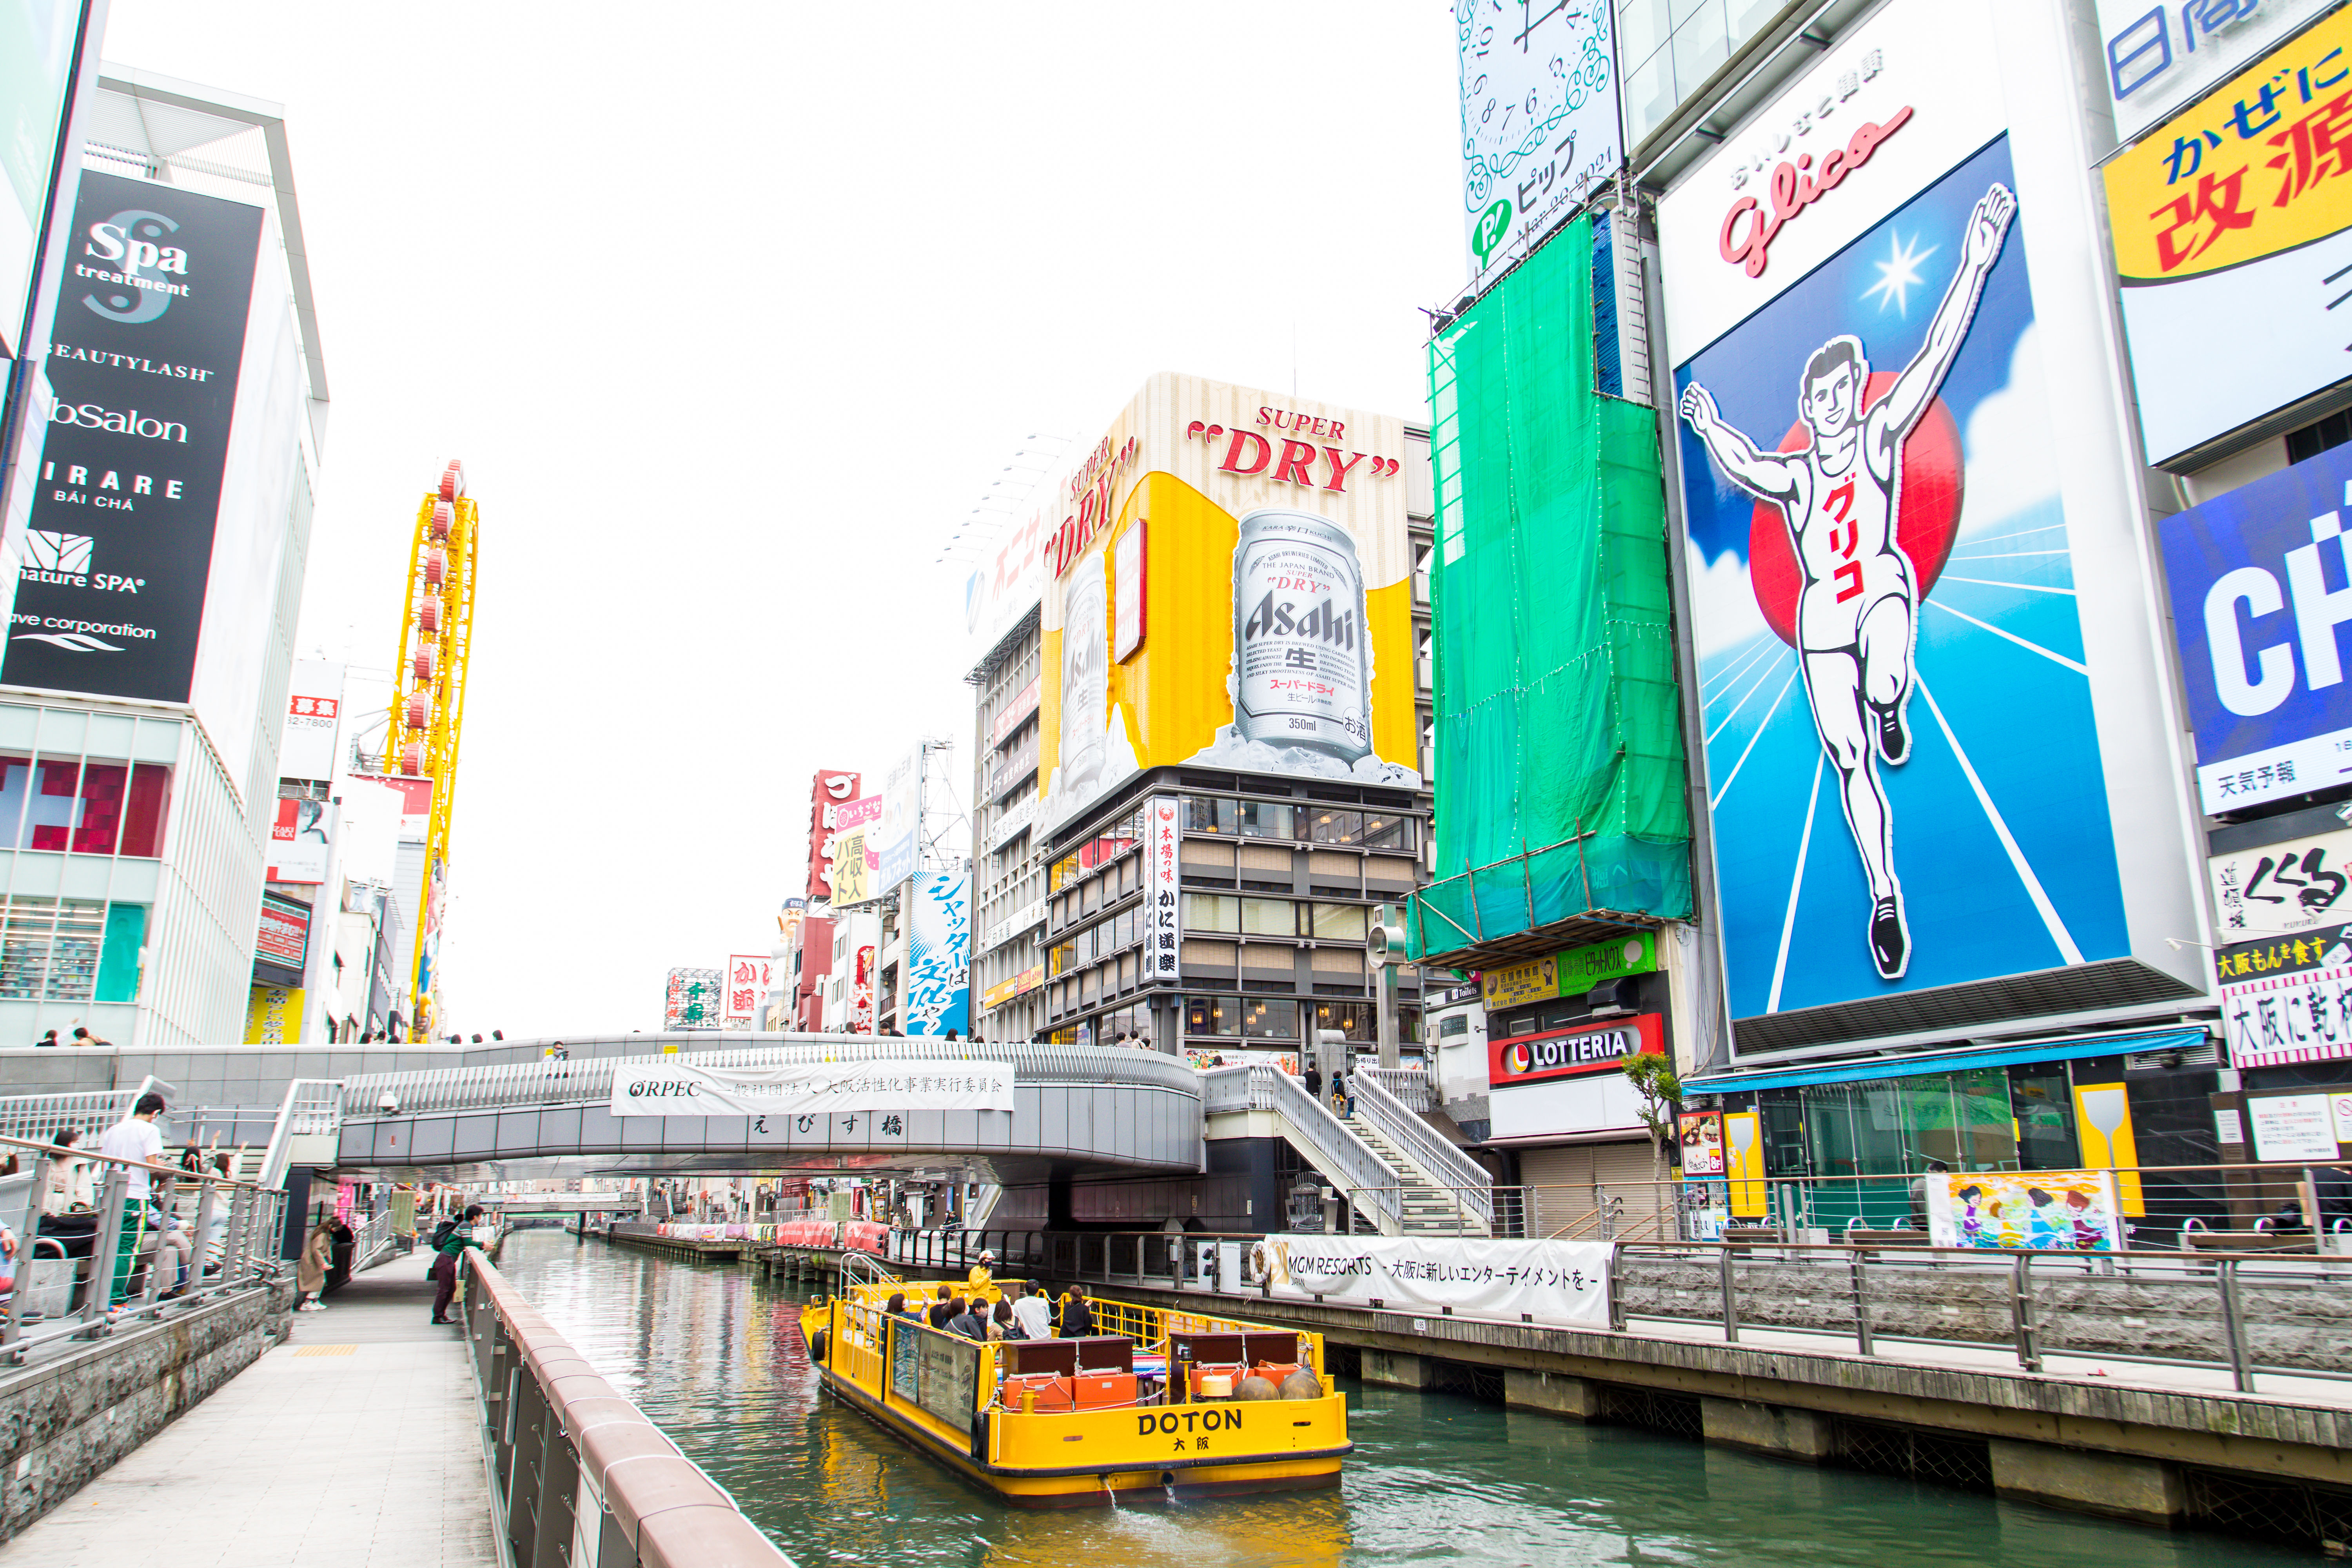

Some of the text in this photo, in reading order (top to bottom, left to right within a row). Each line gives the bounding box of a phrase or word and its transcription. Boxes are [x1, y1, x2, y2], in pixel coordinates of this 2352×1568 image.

[1566, 7, 1582, 30] 4
[1476, 26, 1493, 61] 10
[1549, 53, 1563, 78] 5
[1474, 74, 1488, 95] 9
[1482, 98, 1495, 123] 8
[1526, 87, 1537, 114] 6
[1502, 104, 1516, 131] 7
[2161, 46, 2350, 186] かぜに
[1517, 129, 1577, 214] ピップ
[1575, 146, 1612, 192] 2021
[2149, 89, 2352, 272] 改源
[85, 222, 189, 276] Spa
[75, 263, 191, 297] treatment
[1256, 406, 1345, 440] SUPER
[1070, 435, 1111, 503] SUPER
[1284, 525, 1309, 534] 辛口
[1309, 530, 1333, 541] KUCHI
[1822, 471, 1865, 604] グリコ
[1115, 526, 1140, 575] ASAHI
[1268, 550, 1328, 570] ASAHI BREWERIES LIMITED
[20, 568, 87, 587] nature
[1286, 570, 1313, 579] SUPER
[1308, 566, 1334, 579] BRAND
[1116, 572, 1140, 619] 1889
[44, 617, 157, 639] corporation
[1115, 608, 1140, 657] OSAKA
[1245, 589, 1354, 652] Asahi
[1285, 648, 1317, 671] 生
[1319, 660, 1343, 671] BREWING
[1330, 655, 1355, 671] INGREDIENTS
[1332, 650, 1355, 664] CAREFULLY
[1270, 679, 1334, 697] スーパードライ
[1332, 677, 1347, 687] SUPER
[1346, 676, 1356, 684] TASTE
[290, 698, 335, 716] 募集
[1078, 688, 1089, 713] 生
[1287, 692, 1316, 704] 生ビール
[1289, 718, 1316, 731] 350ml
[1345, 716, 1367, 742] お酒
[994, 775, 1003, 795] 7F
[2218, 760, 2296, 799] 天気予報
[848, 835, 864, 900] 高収入
[1159, 826, 1174, 884] 本場の味
[836, 838, 851, 903] バイト
[2243, 847, 2347, 913] くくる
[2220, 861, 2247, 928] 道頓堀
[1024, 901, 1044, 927] 白木屋
[928, 876, 970, 987] シャッターは
[993, 922, 1011, 946] 白木屋
[1585, 946, 1622, 976] ピタットハウス
[2217, 936, 2327, 978] 大阪もんを食す
[1500, 965, 1539, 983] 店舗情報館
[1459, 986, 1477, 998] Toilets
[1492, 999, 1507, 1007] 株式会社
[848, 983, 873, 1034] 大阪
[1533, 1031, 1628, 1067] LOTTERIA
[629, 1078, 1003, 1098] ORPEC 一般社団法人 大阪活性化事業実行委員会
[753, 1114, 902, 1137] えびす橋
[1710, 1156, 1720, 1169] 8F
[1289, 1256, 1315, 1274] MGM
[1317, 1256, 1371, 1276] RESORTS
[1291, 1277, 1305, 1287] JAPAN
[1138, 1409, 1242, 1436] DOTON
[1173, 1436, 1210, 1451] 大阪
